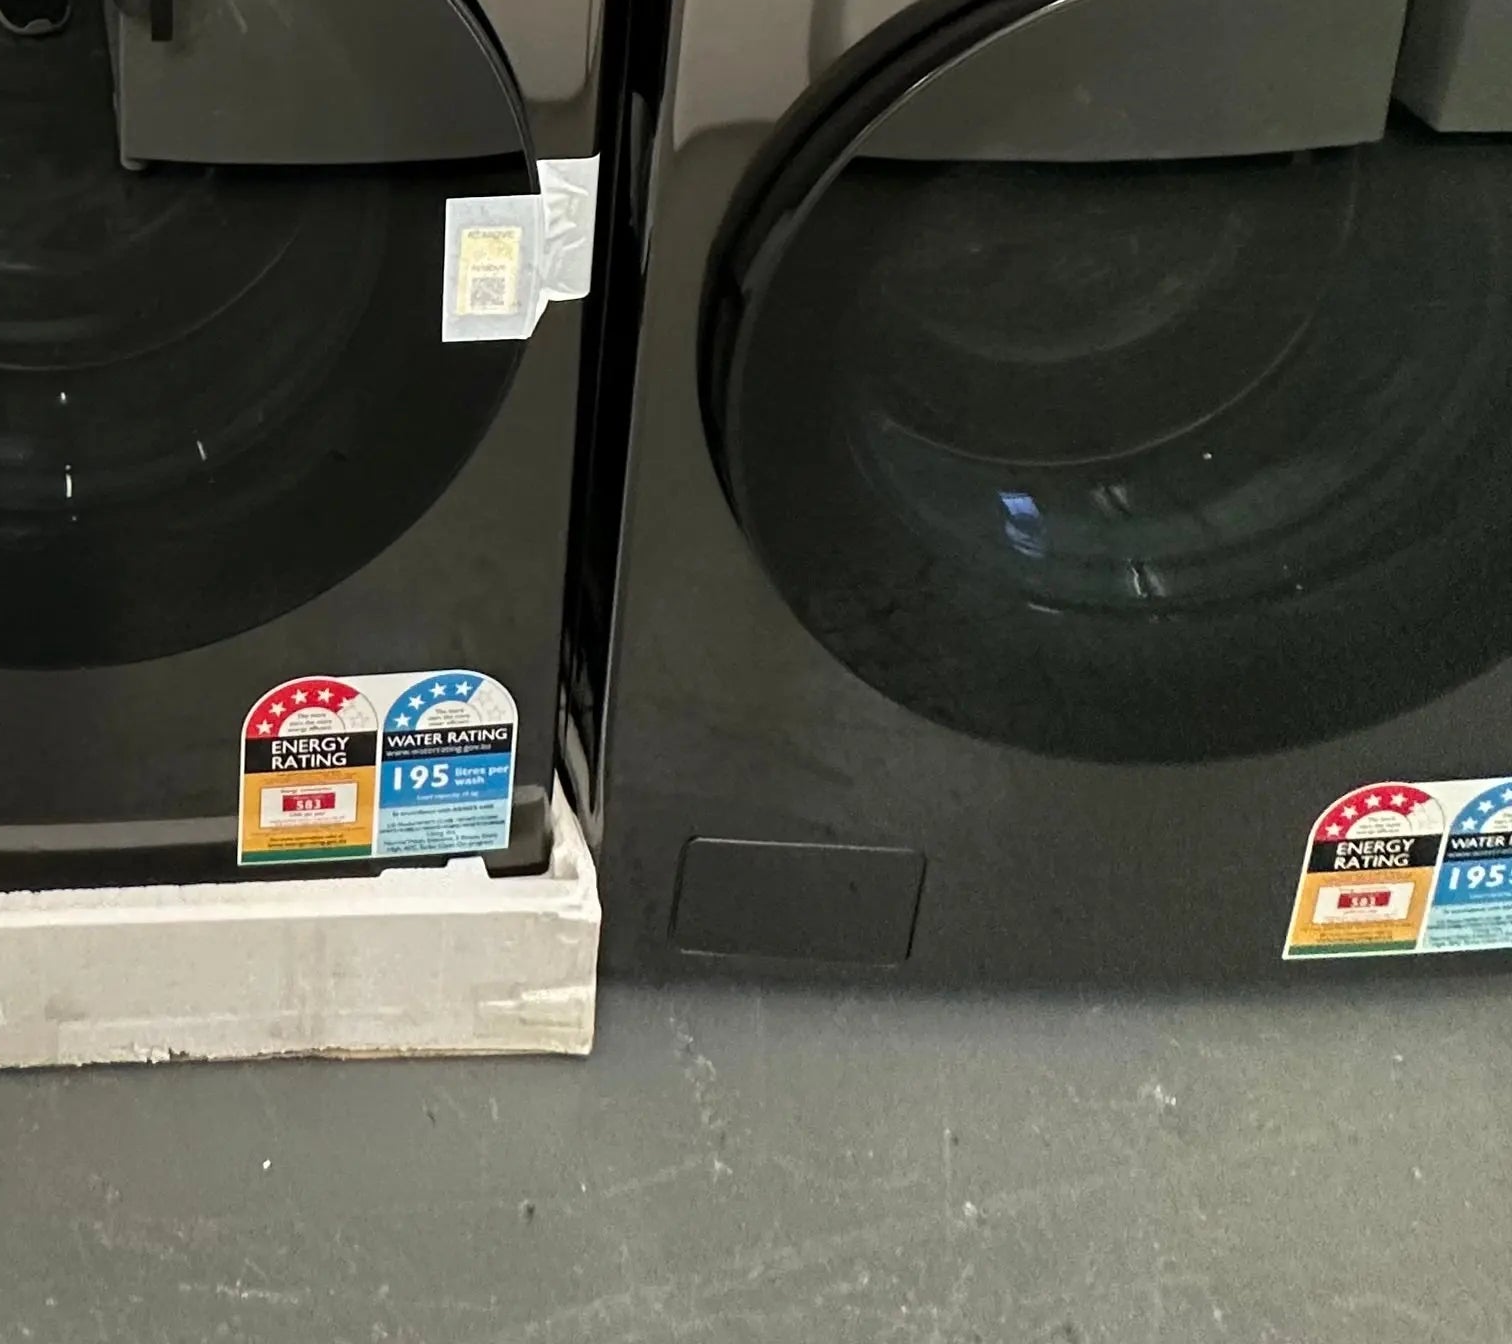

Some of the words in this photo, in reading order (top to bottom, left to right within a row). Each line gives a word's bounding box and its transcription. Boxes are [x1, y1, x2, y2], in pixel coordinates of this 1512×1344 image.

[271, 736, 350, 755] ENERGY
[388, 731, 443, 747] WATER
[447, 727, 508, 744] RATING
[271, 752, 347, 770] RATING
[392, 763, 450, 791] 195
[454, 766, 486, 777] litres
[488, 764, 510, 778] per
[454, 775, 485, 787] wash
[1335, 838, 1415, 856] ENERGY
[1451, 835, 1505, 850] WATER
[1333, 853, 1411, 870] RATING
[1448, 863, 1507, 891] 195
